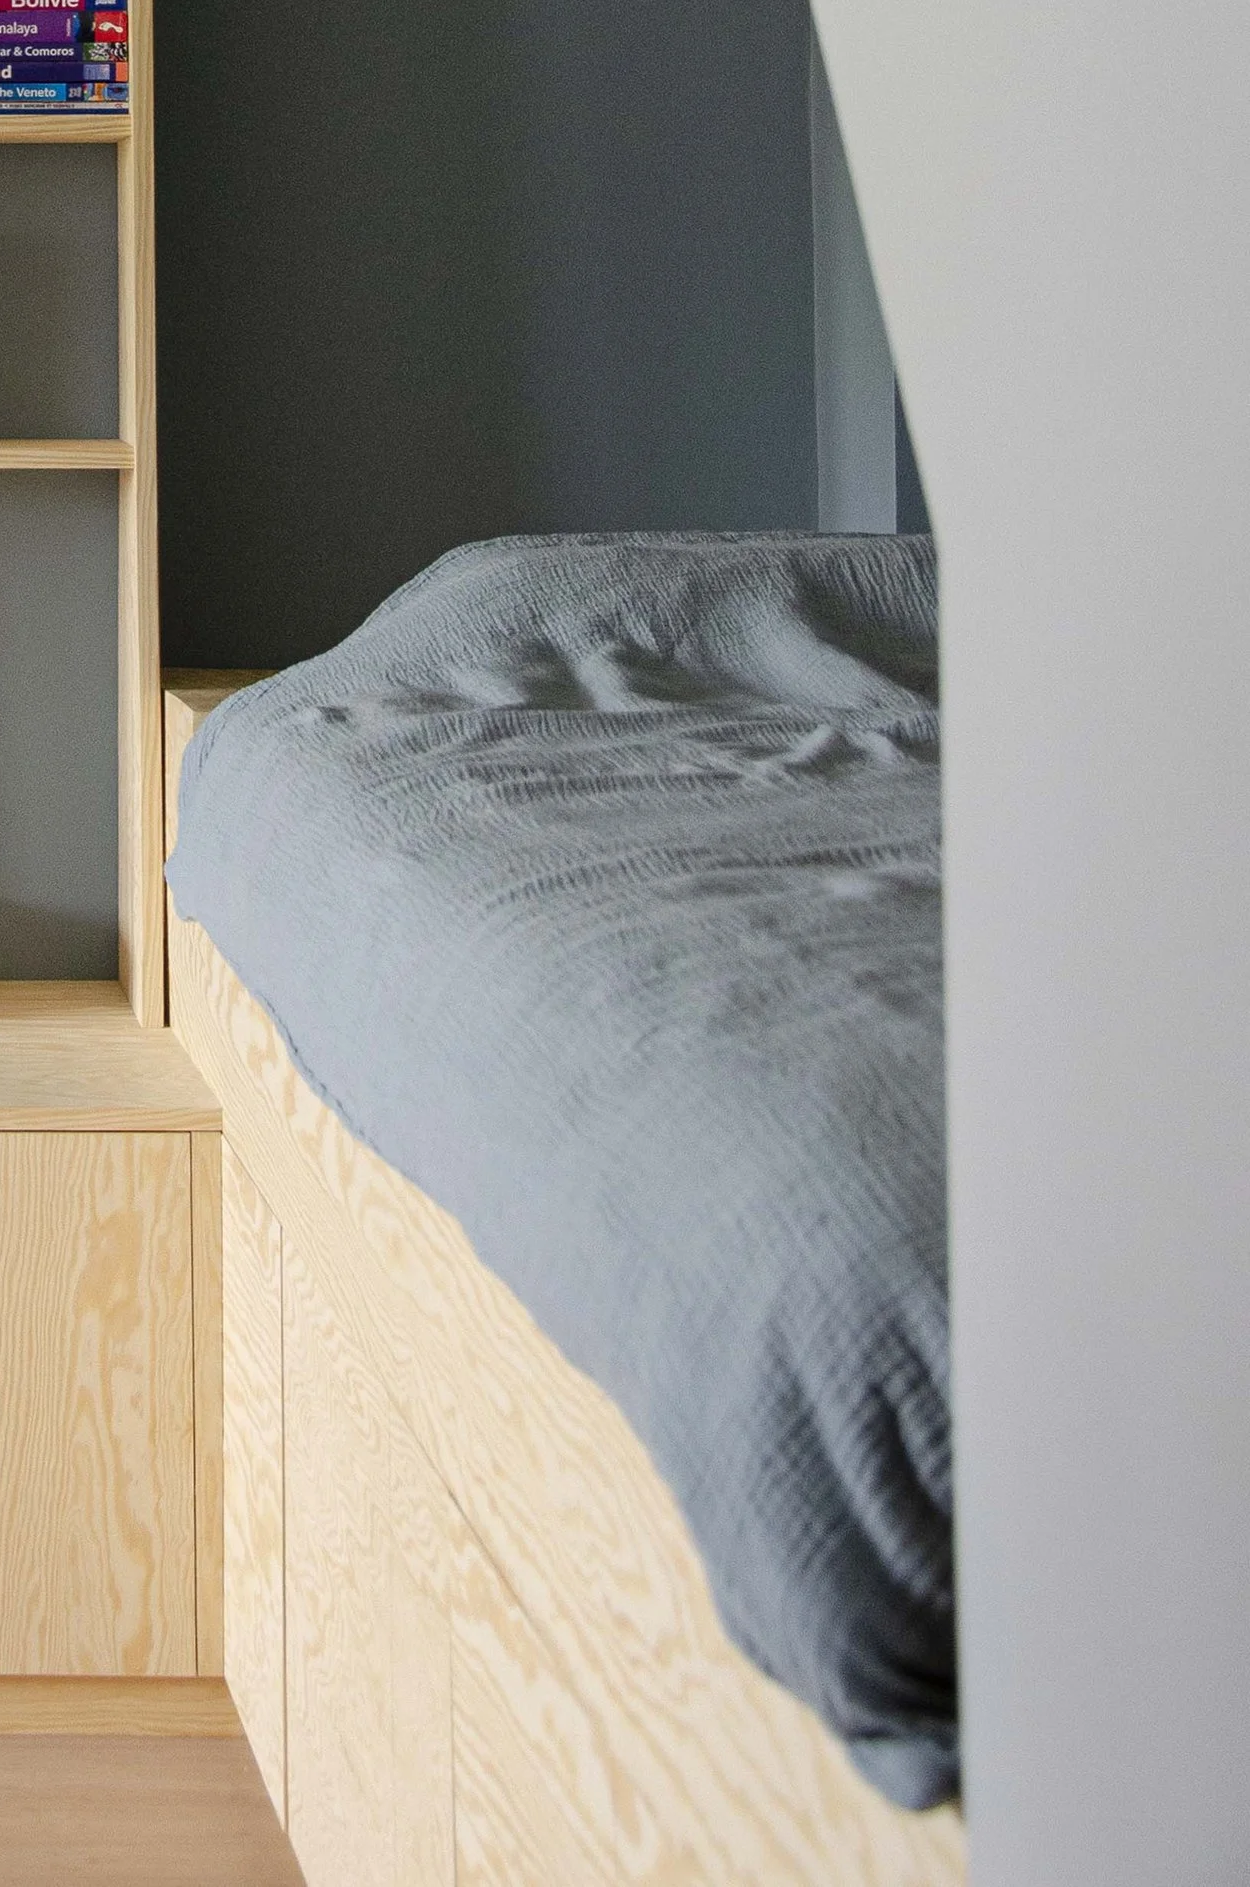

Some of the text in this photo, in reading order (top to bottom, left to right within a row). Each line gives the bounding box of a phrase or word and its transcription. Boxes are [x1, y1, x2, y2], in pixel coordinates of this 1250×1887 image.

[13, 46, 23, 57] &
[24, 46, 75, 57] Comoros
[15, 87, 56, 98] Veneto
